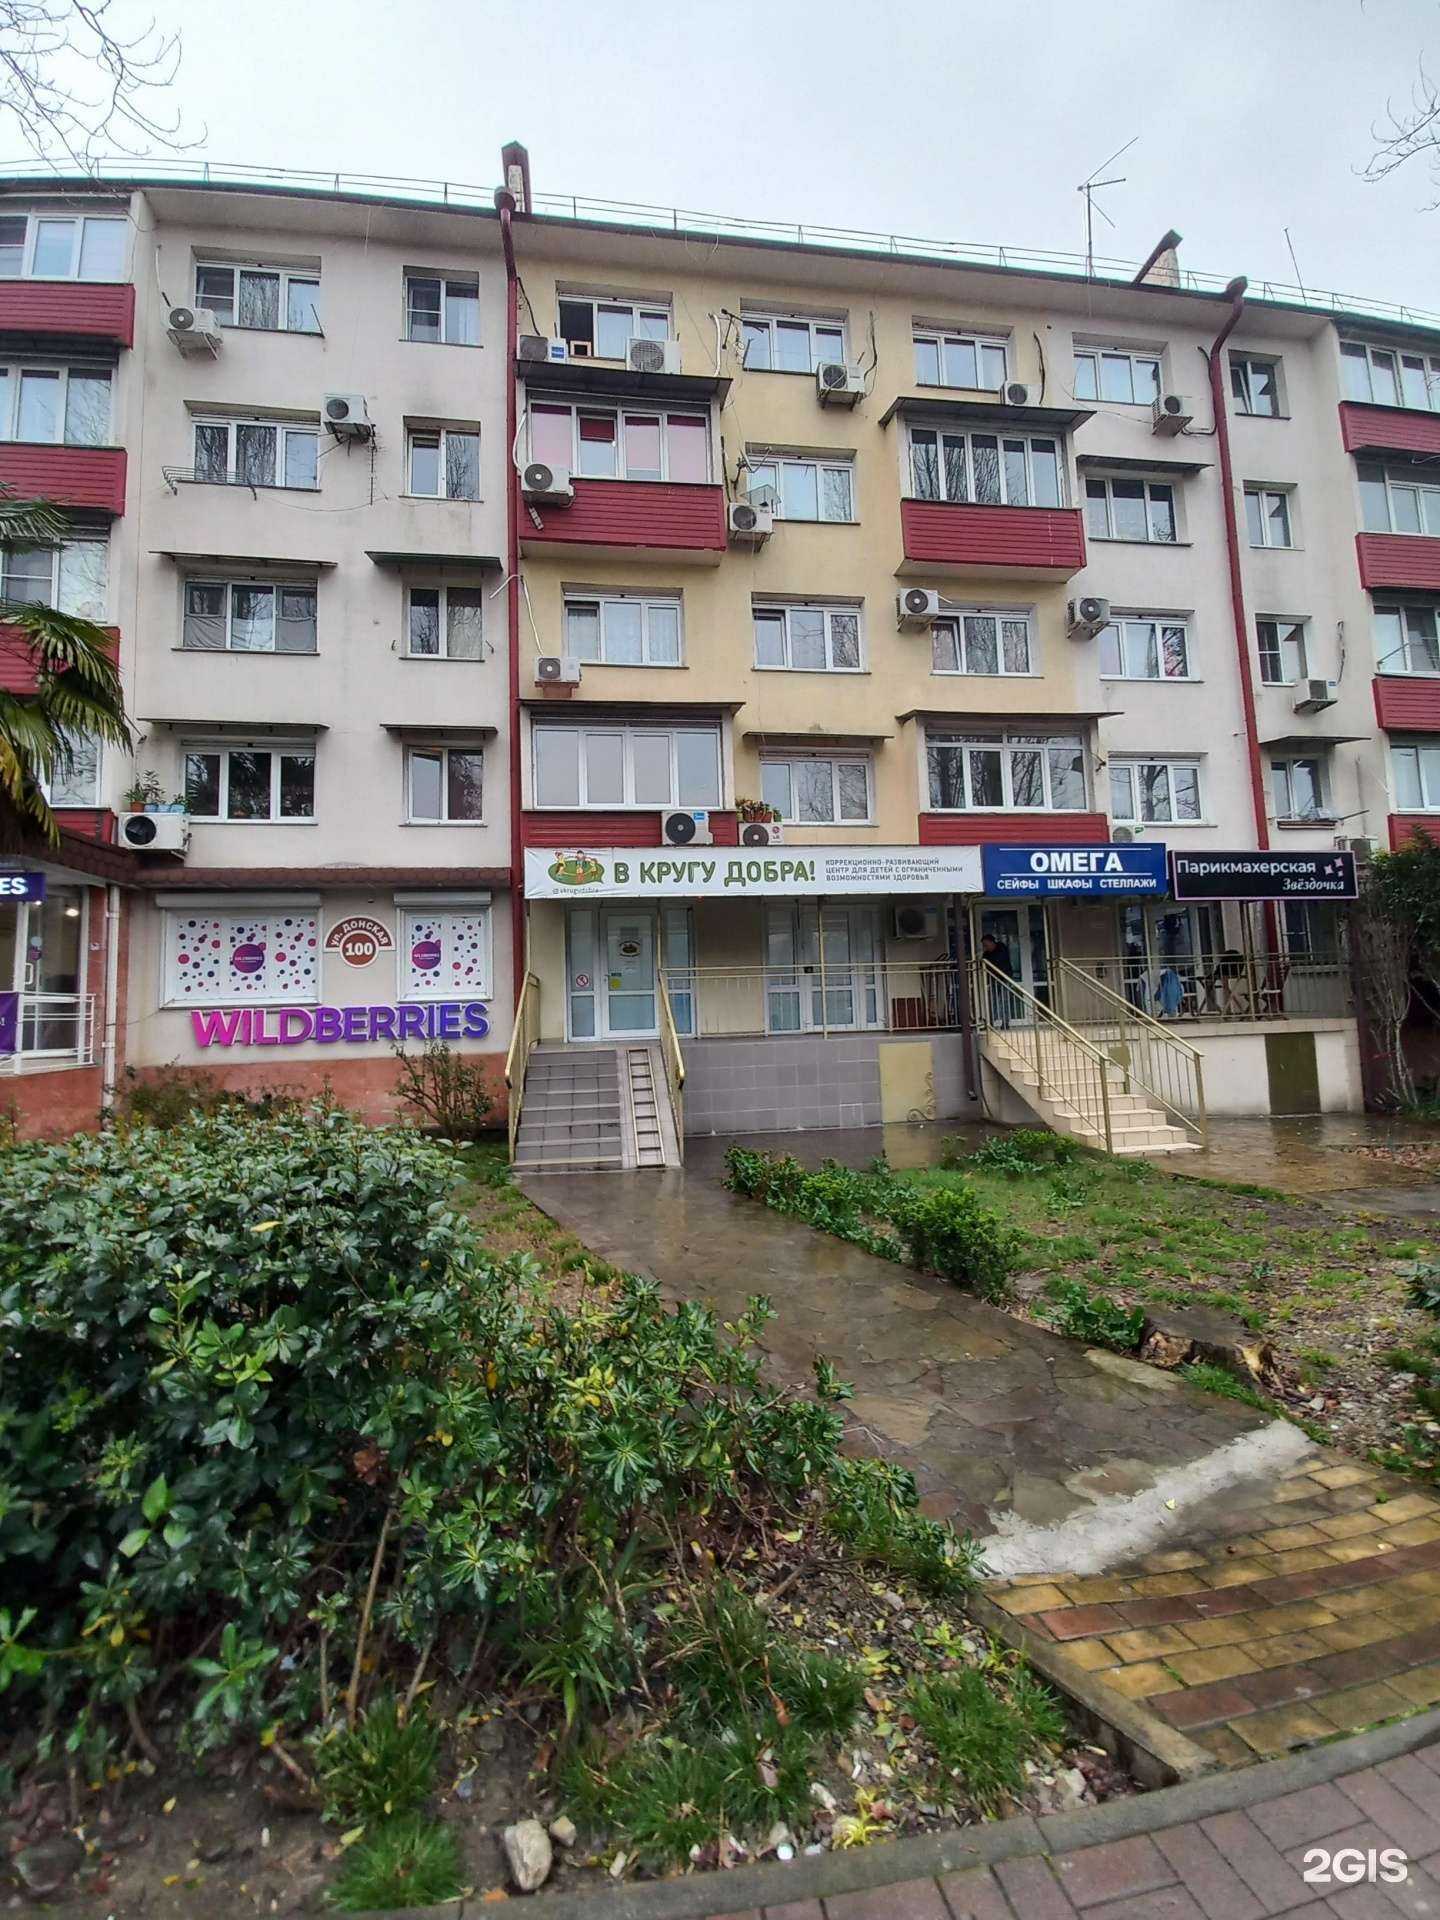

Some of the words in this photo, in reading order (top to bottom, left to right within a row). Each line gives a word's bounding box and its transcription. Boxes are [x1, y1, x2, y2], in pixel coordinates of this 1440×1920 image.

[1030, 852, 1124, 872] ОМЕГА
[1177, 860, 1316, 877] Парикмахерская
[614, 861, 630, 884] В
[639, 861, 716, 884] КРУГУ
[724, 860, 816, 888] ДОБРА!
[825, 866, 850, 875] ЦЕНТР
[851, 866, 868, 875] ДЛЯ
[869, 865, 894, 875] ДЕТЕЙ
[895, 866, 900, 874] С
[826, 873, 891, 882] ВОЗМОЖНОСТЯМИ
[893, 873, 930, 882] ЗДОРОВЬЯ
[996, 877, 1039, 890] СЕЙФЫ
[1047, 878, 1093, 889] ШКАФЫ
[1099, 878, 1157, 889] СТЕЛЛАЖИ
[1282, 877, 1344, 891] Звёздочка
[342, 920, 389, 945] ДОНСКАЯ
[345, 942, 374, 956] 100
[191, 1002, 490, 1047] WILDBERRIES
